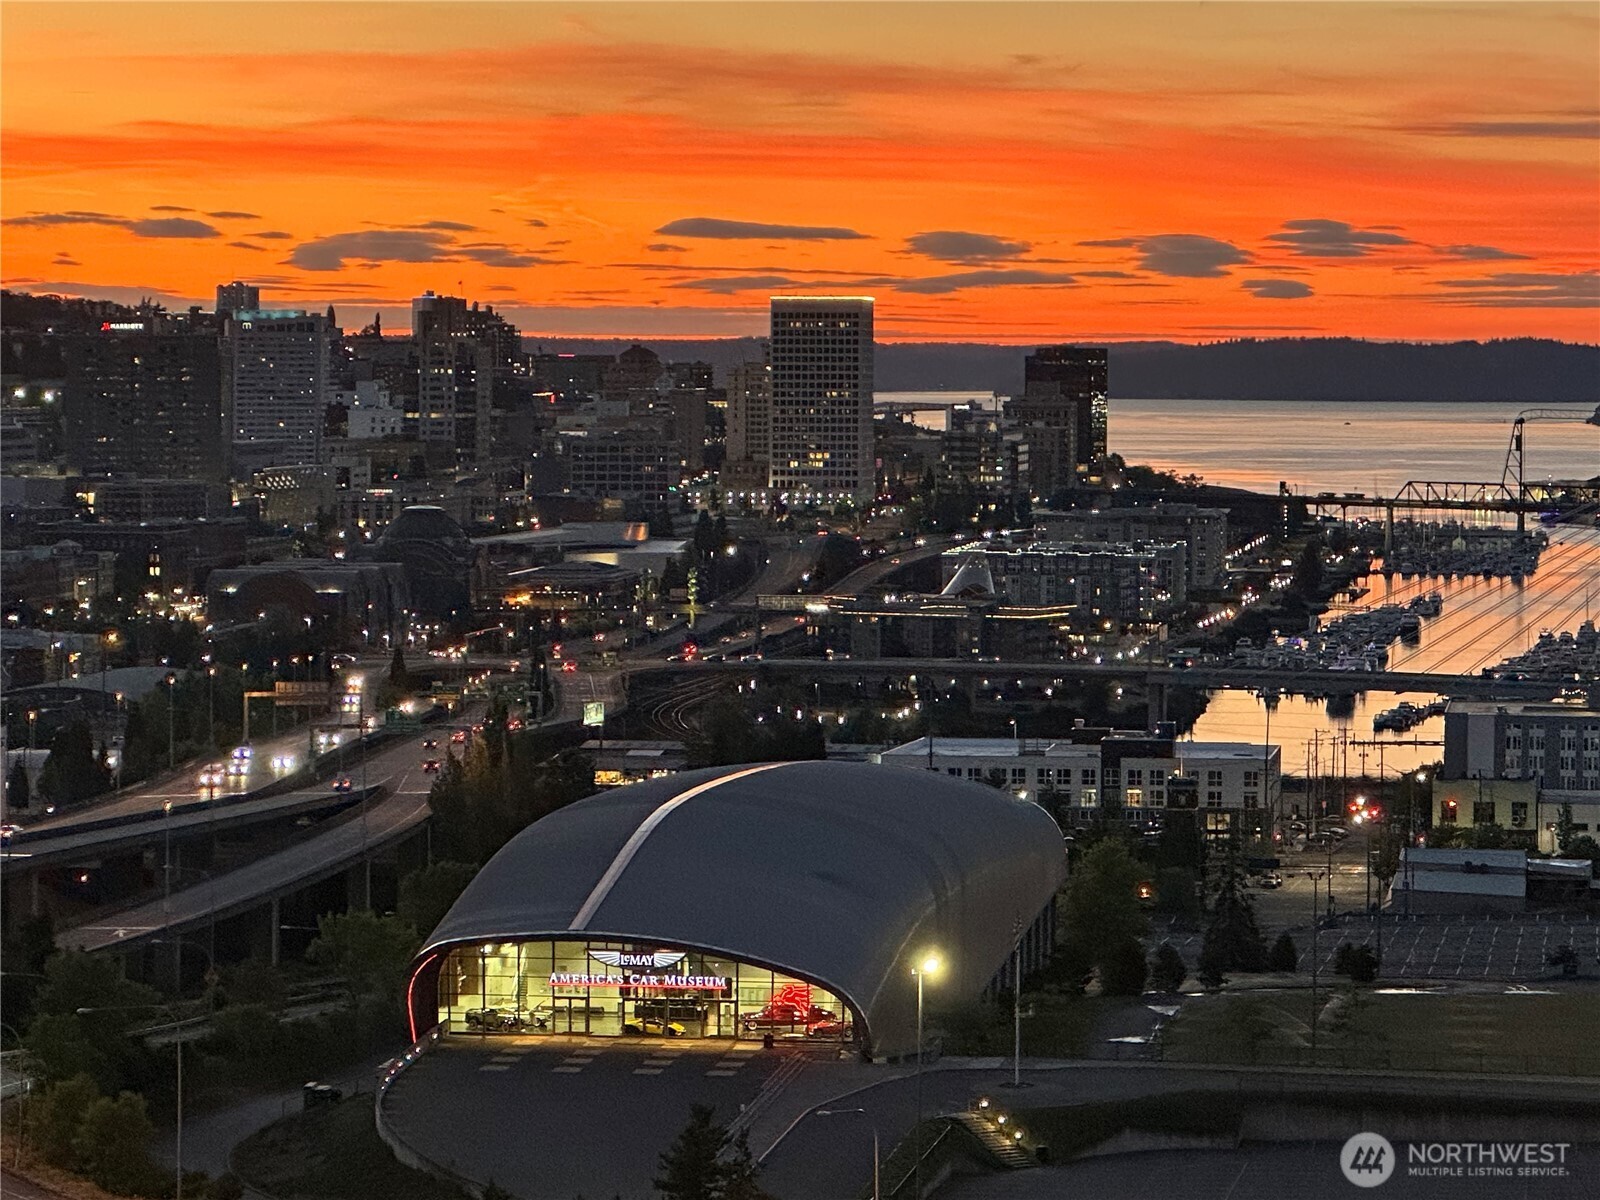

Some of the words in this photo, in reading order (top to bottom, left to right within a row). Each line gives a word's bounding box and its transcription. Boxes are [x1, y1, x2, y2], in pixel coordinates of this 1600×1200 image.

[549, 972, 624, 985] AMERICA'S
[629, 974, 659, 986] CAR
[663, 975, 726, 987] MUSEUM
